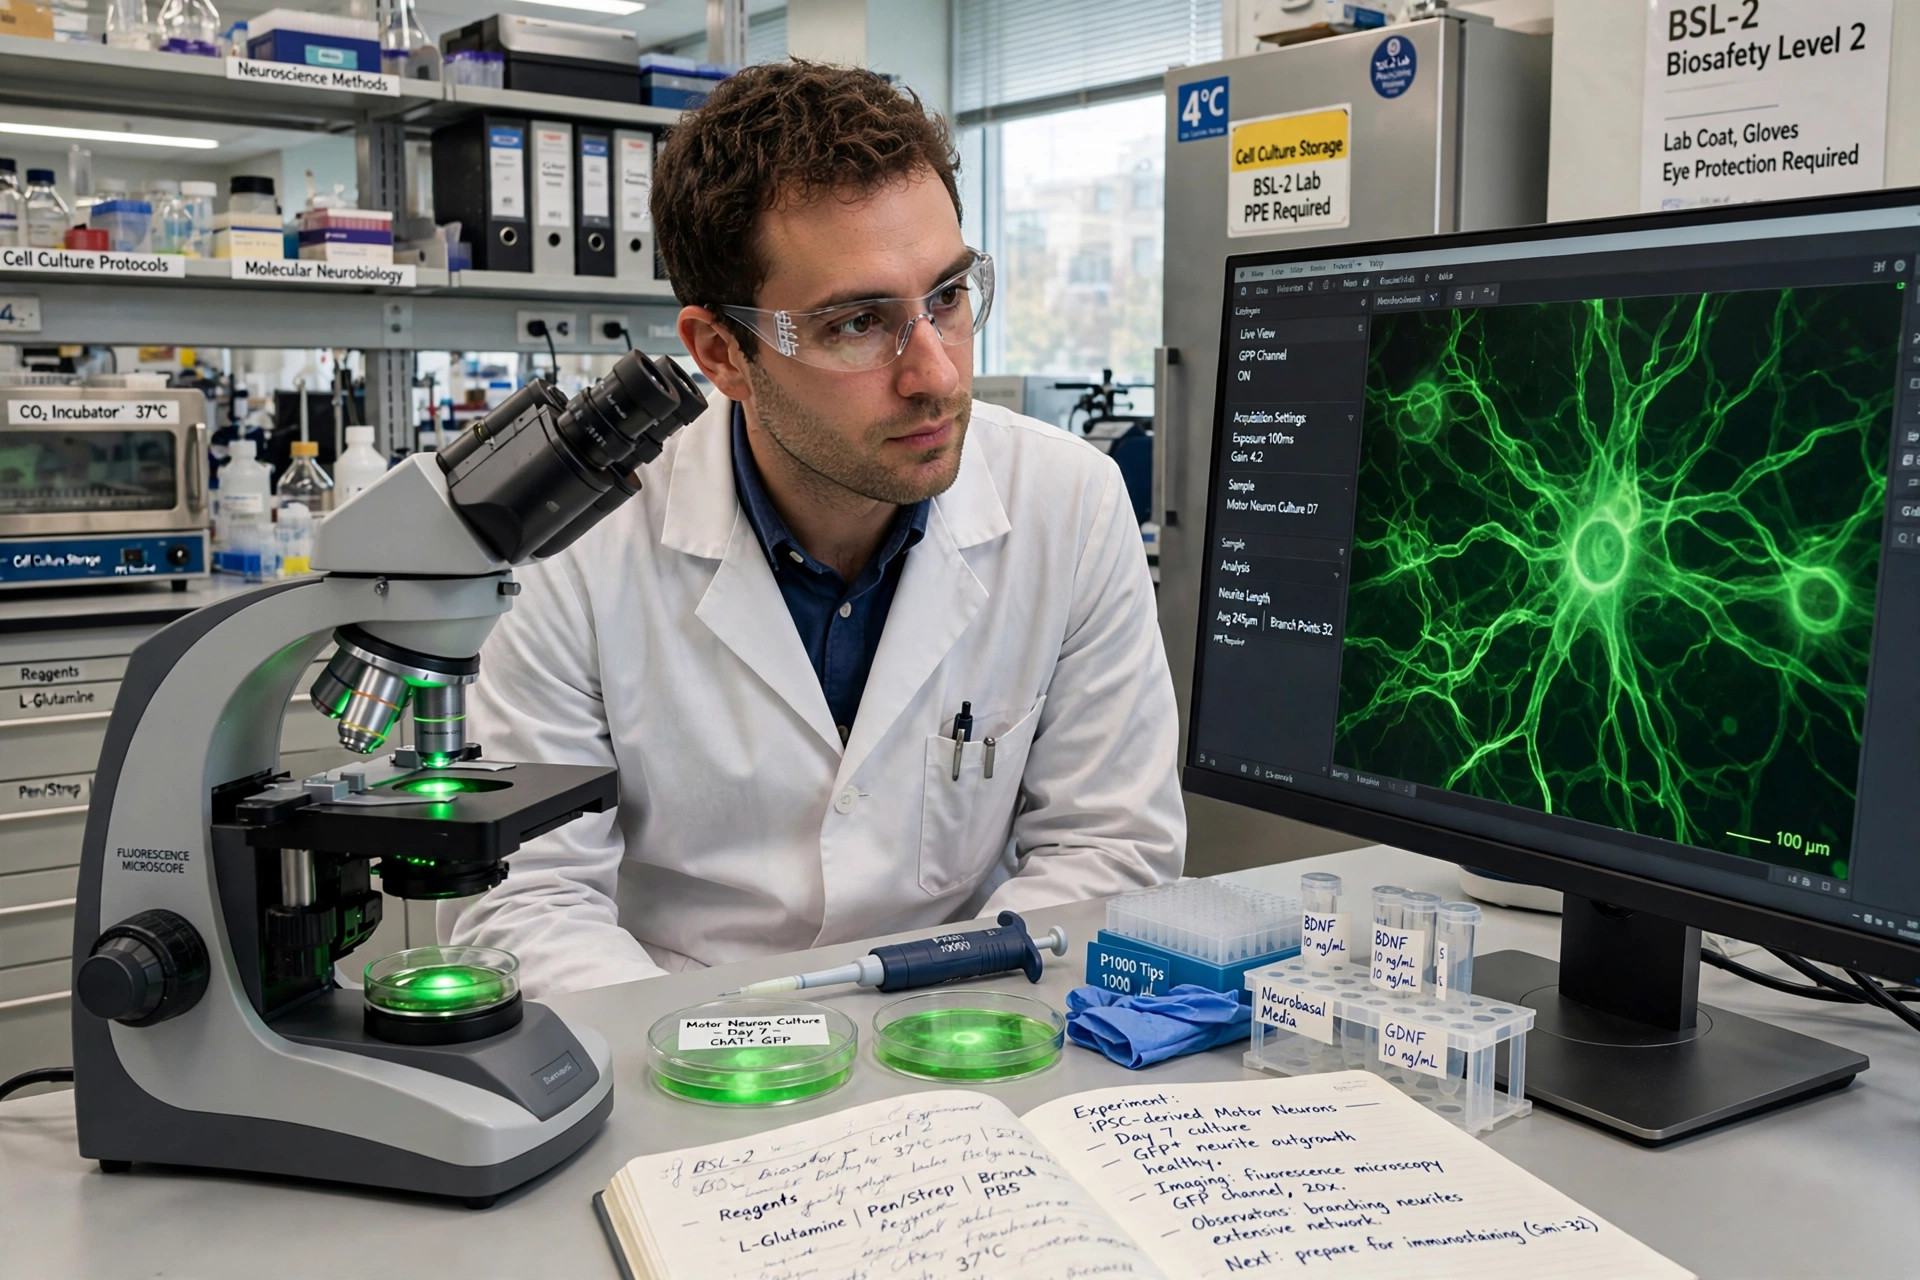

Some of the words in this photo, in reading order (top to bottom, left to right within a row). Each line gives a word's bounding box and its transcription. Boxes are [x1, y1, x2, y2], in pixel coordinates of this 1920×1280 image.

[1668, 0, 1759, 41] BSL-2
[1667, 41, 1771, 76] Biosafety
[1778, 26, 1841, 61] Level
[1850, 22, 1866, 51] 2
[238, 62, 328, 85] Neuroscience
[332, 72, 388, 92] Methods
[1181, 85, 1225, 127] 4°C
[1664, 132, 1691, 151] Lab
[1697, 127, 1738, 148] Coat,
[1743, 122, 1799, 143] Gloves
[1235, 147, 1255, 165] Cell
[1257, 142, 1296, 163] Culture
[1299, 138, 1343, 159] Storage
[1663, 162, 1691, 186] Eye
[1695, 153, 1777, 178] Protection
[1782, 143, 1860, 174] Required
[1253, 174, 1292, 197] BSL-2
[1296, 170, 1321, 191] Lab
[1244, 201, 1269, 222] PPE
[1273, 196, 1331, 222] Required
[4, 251, 33, 266] Cell
[38, 252, 95, 269] Culture
[100, 255, 169, 272] Protocols
[245, 261, 312, 277] Molecular
[317, 265, 403, 285] Neurobiology
[1240, 328, 1256, 340] Live
[1257, 327, 1276, 339] View
[1257, 348, 1288, 361] Channel
[1238, 370, 1251, 381] ON
[52, 404, 120, 419] Incubator
[135, 405, 168, 419] 37°C
[1233, 411, 1273, 426] Acquisition
[1233, 432, 1266, 447] Exposure
[1268, 433, 1294, 445] 100ms
[1231, 451, 1248, 463] Gain
[1250, 451, 1264, 463] 4.2
[1228, 479, 1255, 494] Sample
[1227, 499, 1249, 511] Motor
[1250, 500, 1276, 513] Neuron
[1278, 501, 1305, 515] Culture
[1306, 503, 1318, 515] D7
[1221, 560, 1250, 575] Analysis
[1218, 588, 1244, 601] Neurite
[1246, 589, 1271, 606] Length
[1216, 610, 1232, 626] Avg
[1270, 616, 1296, 631] Branch
[1297, 619, 1321, 634] Points
[1322, 622, 1334, 636] 32
[21, 666, 79, 682] Reagents
[1776, 831, 1802, 850] 100
[117, 847, 190, 862] FLUORESCENCE
[122, 861, 185, 873] MICROSCOPE
[1304, 915, 1336, 933] BDNF
[1303, 935, 1312, 947] 10
[1316, 938, 1346, 957] ng/mL
[1375, 930, 1408, 950] BDNF
[1100, 953, 1137, 973] P1000
[1139, 961, 1164, 982] Tips
[1374, 950, 1383, 962] 10
[1386, 954, 1415, 970] ng/mL
[1102, 973, 1131, 992] 1000
[1373, 968, 1382, 980] 10
[1384, 972, 1417, 989] ng/mL
[1262, 986, 1326, 1017] Neurobasal
[686, 1020, 722, 1029] Motor
[728, 1019, 771, 1027] Neuron
[776, 1017, 820, 1026] Culture
[1261, 1005, 1297, 1028] Media
[728, 1028, 754, 1037] Day
[761, 1036, 792, 1045] GFP
[1385, 1022, 1426, 1044] GDNF
[1383, 1043, 1396, 1057] 10
[1402, 1050, 1438, 1070] ng/mL
[1073, 1093, 1179, 1119] Experiment:
[1089, 1107, 1204, 1133] iPSC-derived
[1214, 1106, 1262, 1118] Motor
[1272, 1104, 1337, 1115] Neurons
[1115, 1132, 1154, 1147] Day
[1160, 1126, 1173, 1138] 7
[1188, 1122, 1251, 1135] culture
[1133, 1141, 1181, 1160] GFP+
[1196, 1137, 1259, 1151] neurite
[1271, 1130, 1357, 1149] outgrowth
[692, 1150, 754, 1174] BSL-2
[1154, 1174, 1236, 1195] Imaging:
[1354, 1158, 1444, 1175] microscopy
[984, 1182, 1021, 1199] PBS
[1173, 1192, 1209, 1209] GFP
[1221, 1182, 1293, 1201] channel,
[719, 1193, 798, 1221] Reagents
[1303, 1198, 1390, 1215] branching
[1396, 1192, 1464, 1208] neurites
[739, 1218, 847, 1252] L-Glutamine
[867, 1184, 954, 1217] Pen/Strep
[1213, 1224, 1296, 1245] extensive
[1307, 1214, 1382, 1231] network.
[1225, 1249, 1284, 1272] Next:
[1295, 1242, 1359, 1266] prepare
[1366, 1235, 1395, 1251] for
[1403, 1227, 1526, 1249] immunostaining
